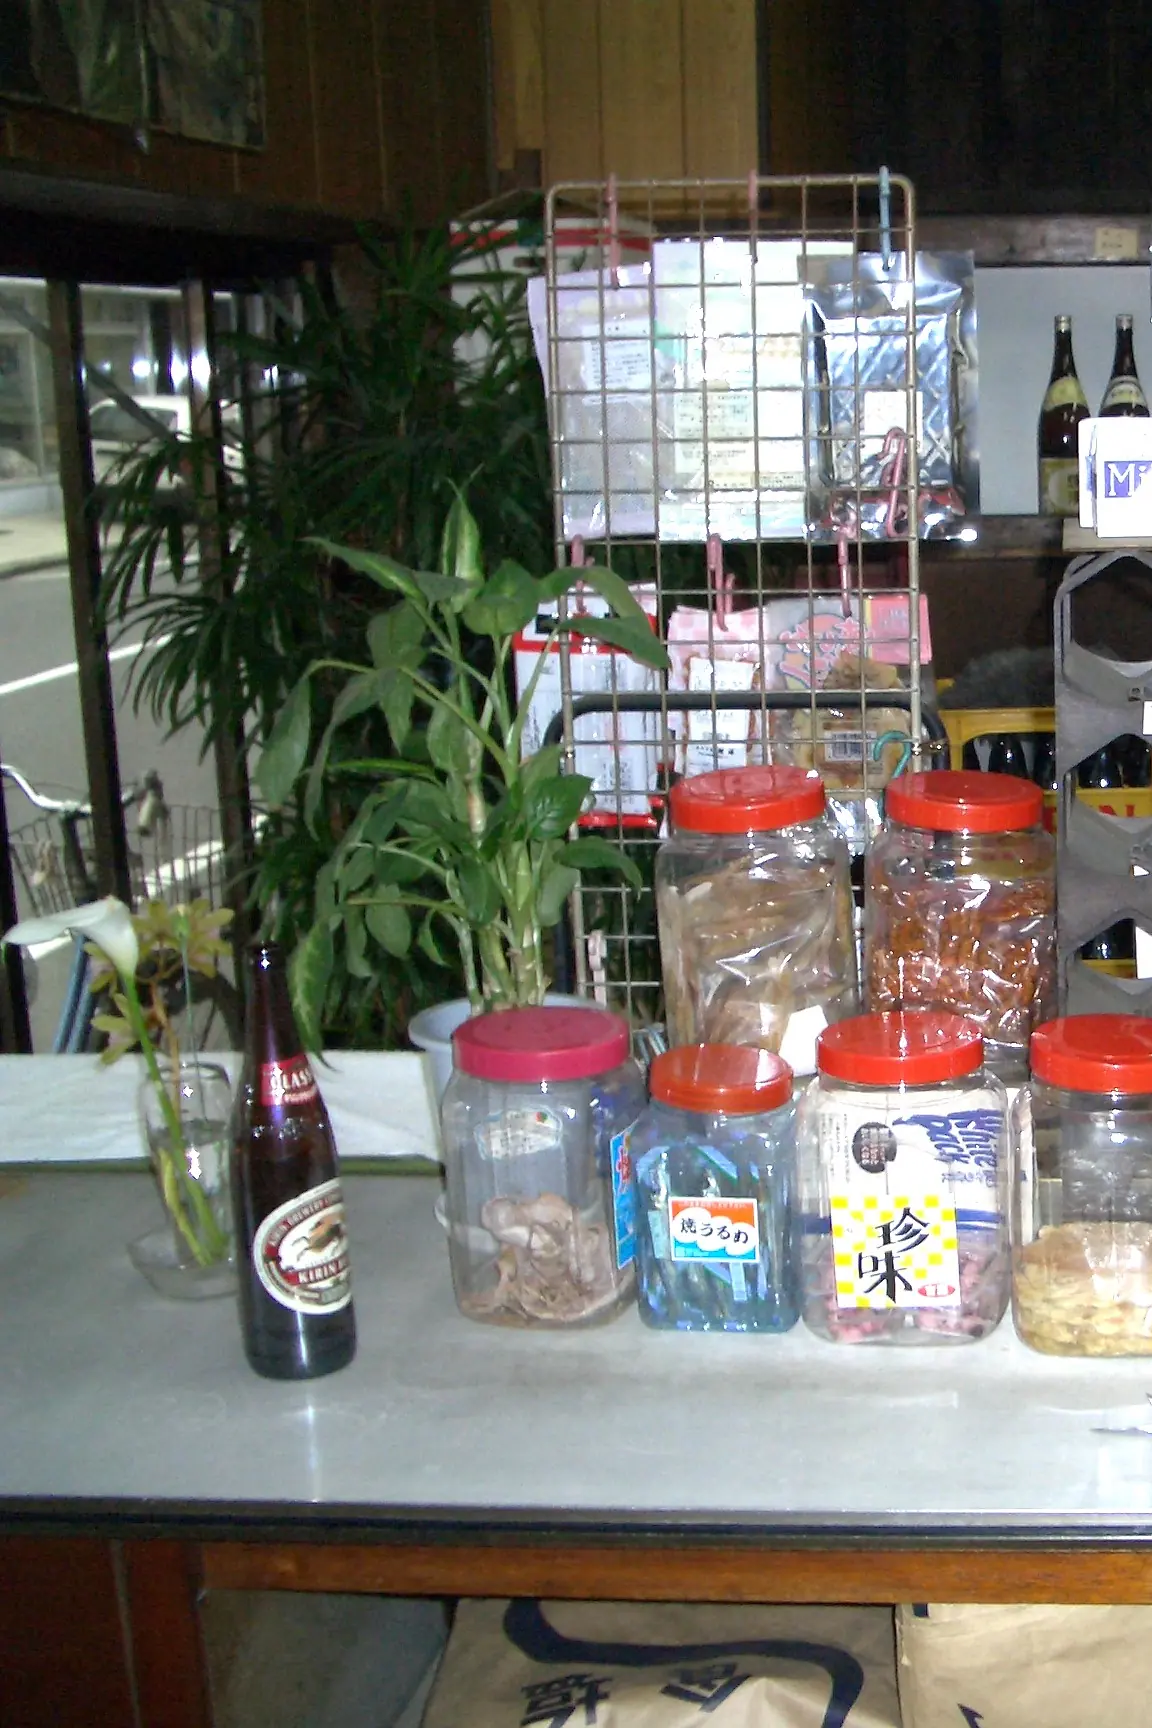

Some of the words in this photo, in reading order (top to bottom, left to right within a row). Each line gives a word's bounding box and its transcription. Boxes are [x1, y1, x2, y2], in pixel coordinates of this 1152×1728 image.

[680, 1217, 749, 1244] 焼うるめ
[859, 1207, 930, 1303] 珍味
